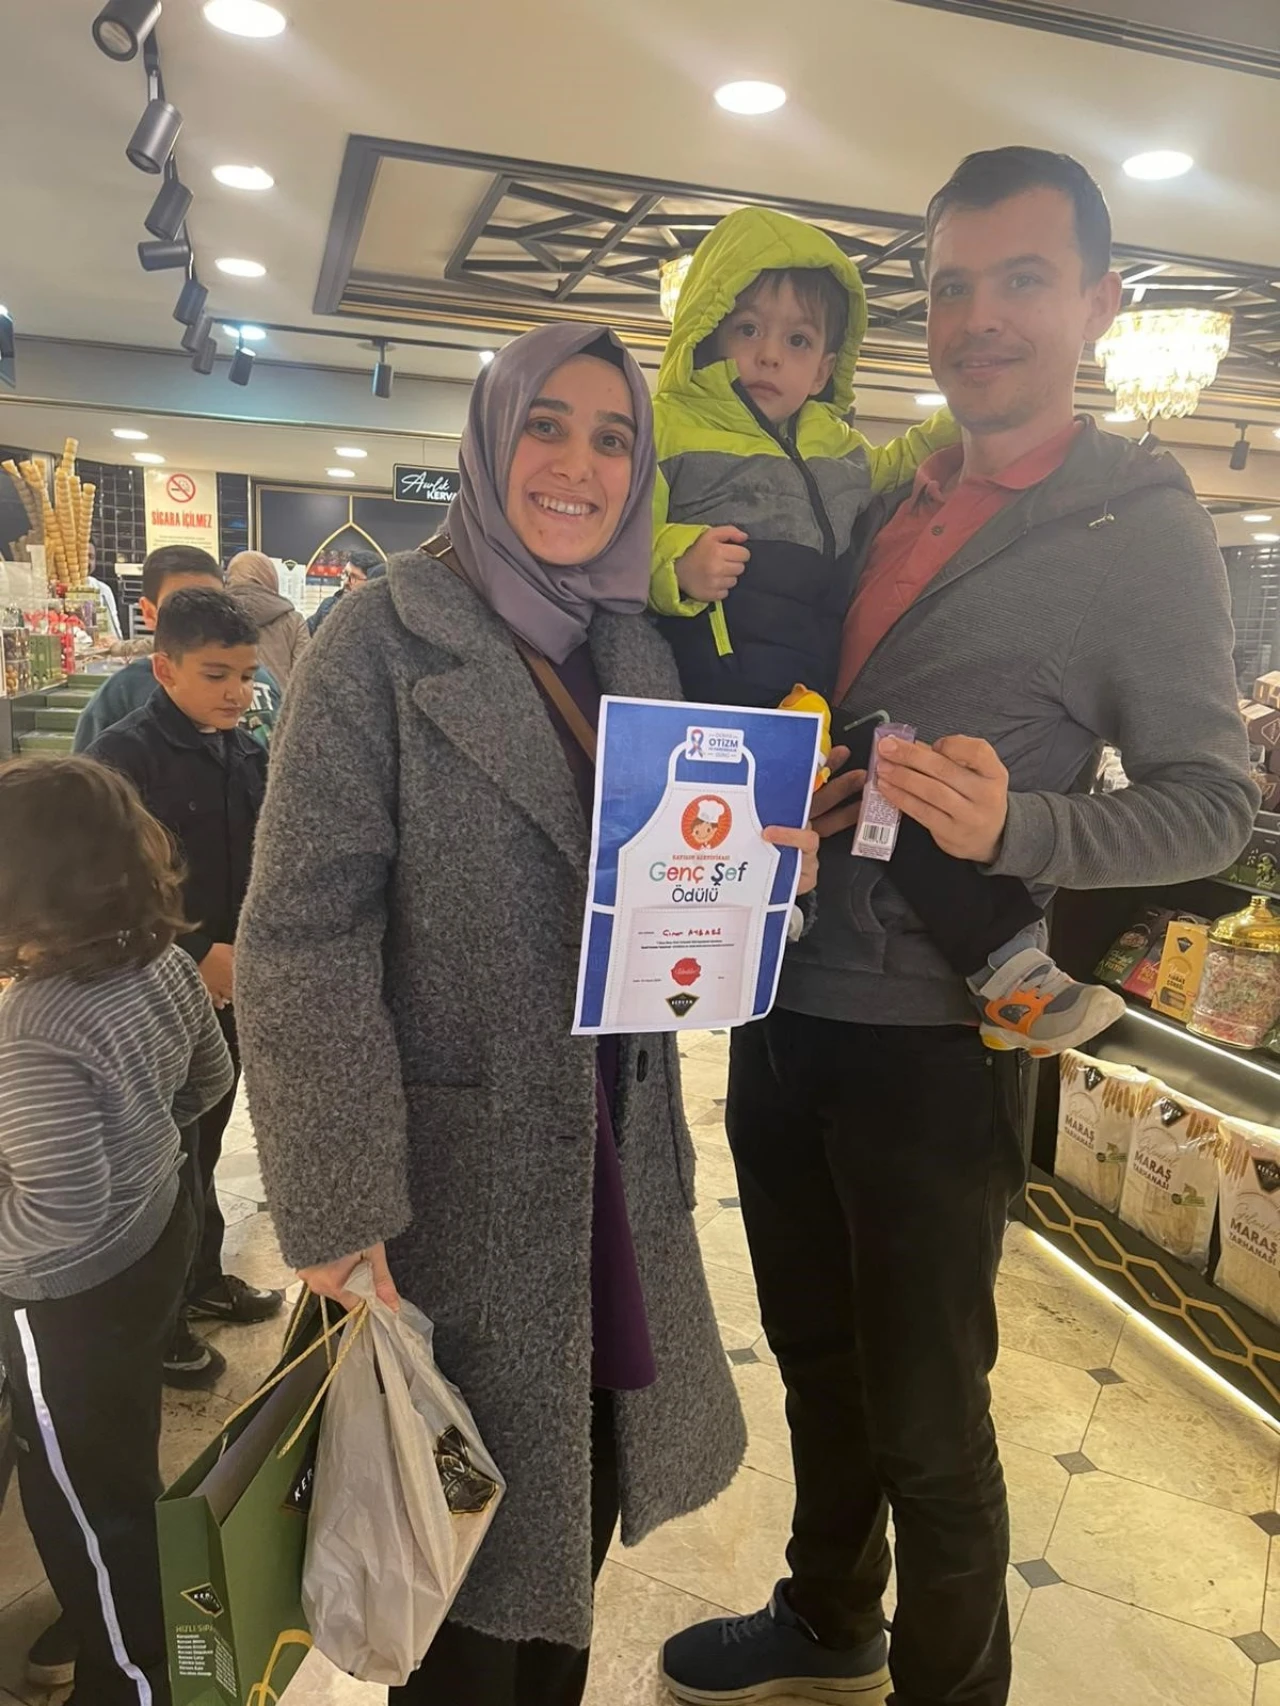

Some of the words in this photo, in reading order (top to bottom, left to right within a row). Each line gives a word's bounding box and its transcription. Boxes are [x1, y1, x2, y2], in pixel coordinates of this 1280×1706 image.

[151, 508, 180, 527] SİGARA
[182, 509, 212, 529] İÇİLMEZ
[708, 738, 738, 748] OTİZM
[649, 861, 705, 884] Genç
[710, 861, 748, 886] Şef
[671, 884, 719, 902] Ödülü
[1134, 1150, 1172, 1182] MARAŞ
[1229, 1232, 1277, 1266] TARHANASI
[1230, 1217, 1278, 1257] MARAŞ
[294, 1467, 314, 1502] KER
